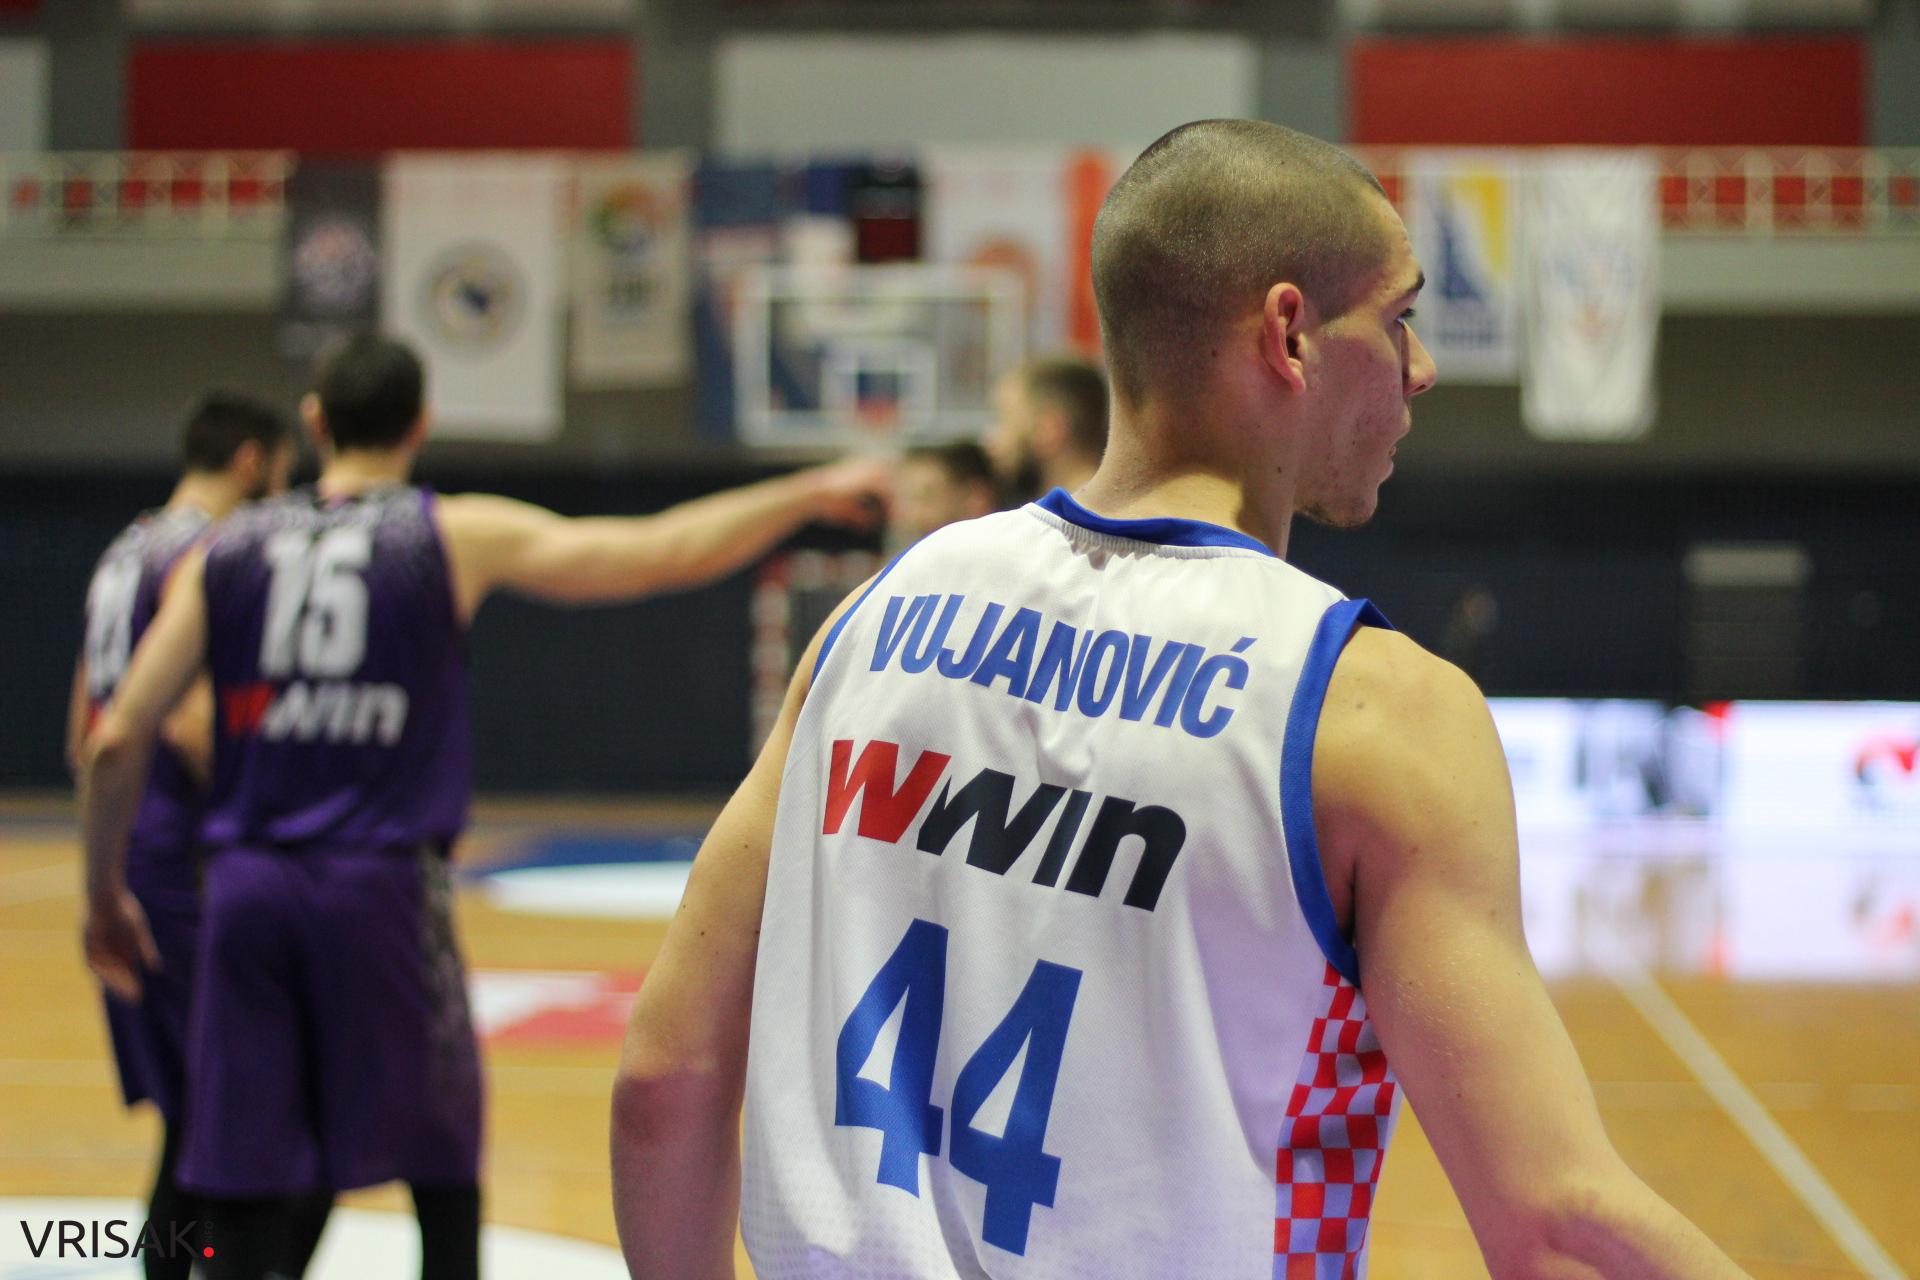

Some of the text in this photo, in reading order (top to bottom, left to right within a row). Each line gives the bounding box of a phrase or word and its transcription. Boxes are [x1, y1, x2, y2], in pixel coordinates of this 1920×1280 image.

[258, 527, 372, 679] 15
[869, 593, 1258, 739] VUJANOVIĆ
[834, 917, 1084, 1257] 44
